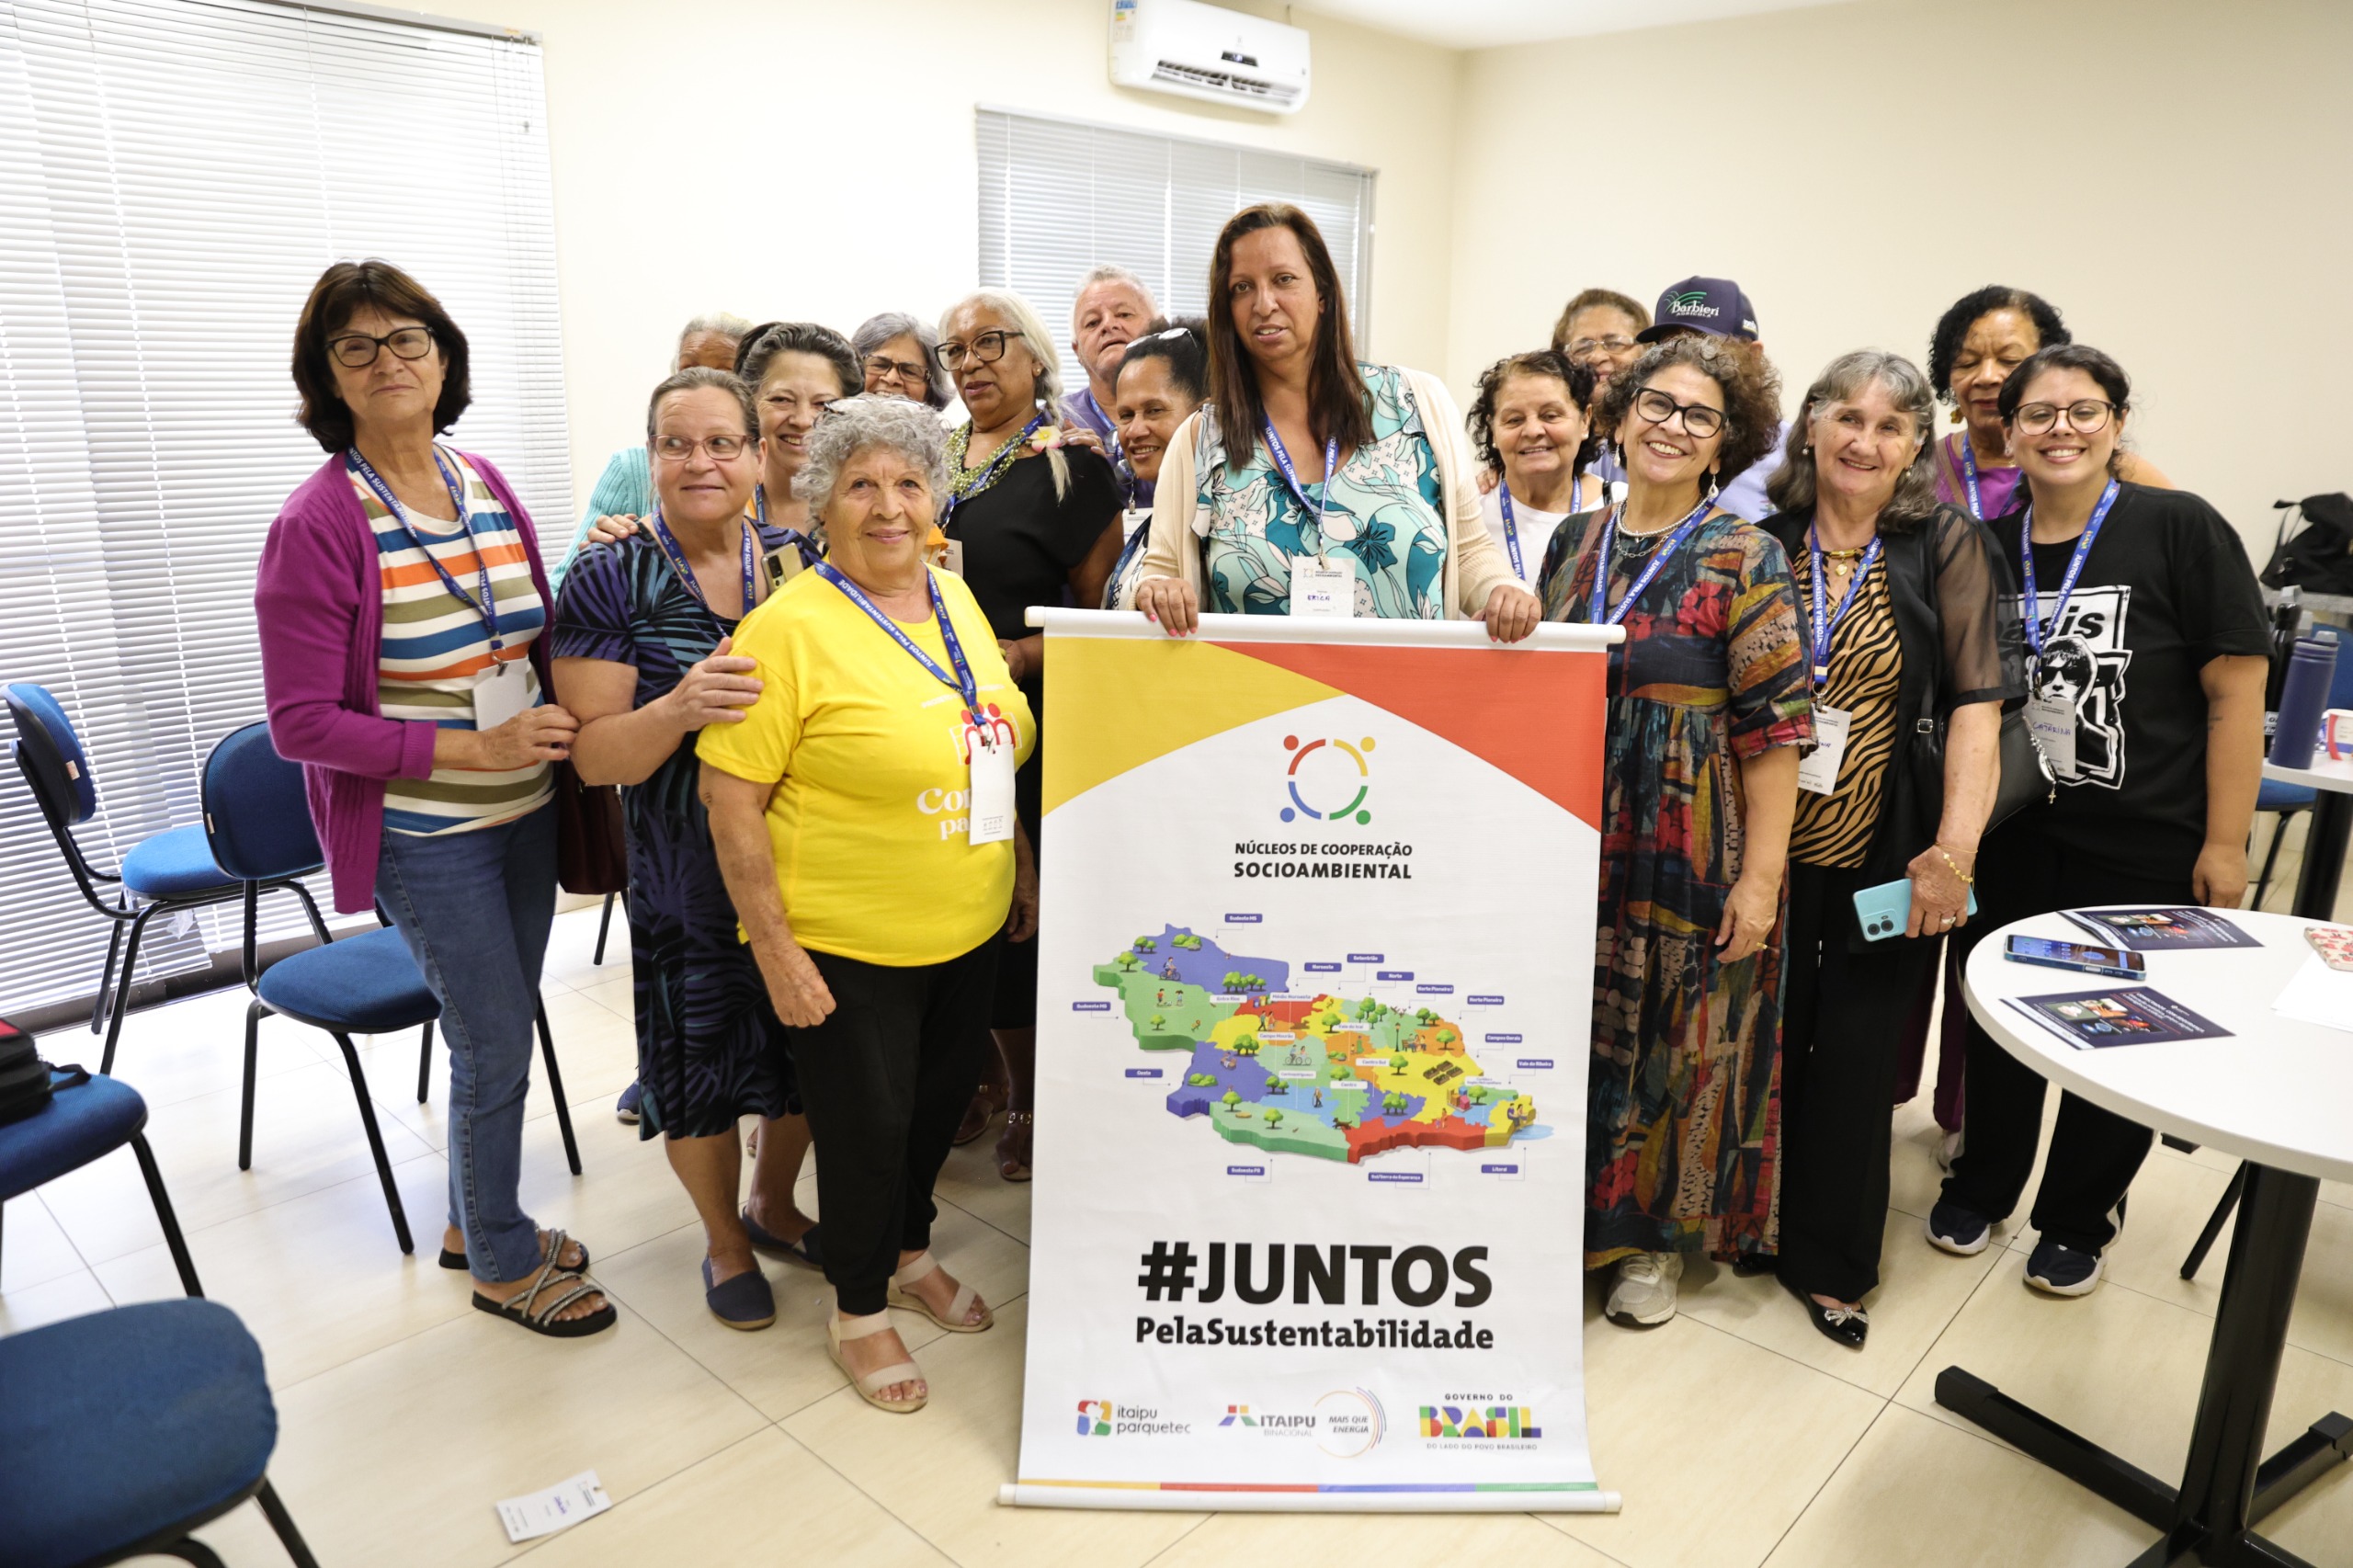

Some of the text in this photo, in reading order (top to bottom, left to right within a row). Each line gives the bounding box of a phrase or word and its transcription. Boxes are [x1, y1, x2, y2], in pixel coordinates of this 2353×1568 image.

[1671, 300, 1720, 316] Barbieri
[348, 447, 364, 464] NTOS
[359, 462, 375, 479] PELA
[1277, 449, 1289, 465] PELA
[1509, 540, 1519, 563] JUNTOS
[1867, 537, 1882, 559] JUNTOS
[1641, 559, 1661, 584] JUNTOS
[2067, 553, 2083, 581] JUNTOS
[481, 570, 490, 586] PELA
[1814, 551, 1823, 609] SUSTENTABILIDADE
[1629, 582, 1643, 597] PELA
[2060, 580, 2073, 596] PELA
[838, 579, 934, 668] JUNTOS PELA SUSTENTABILIDADE
[1235, 840, 1413, 859] NÚCLEOS DE COOPERAÇÃO
[1234, 862, 1412, 879] SOCIOAMBIENTAL
[1138, 1241, 1493, 1308] #JUNTOS
[1136, 1315, 1494, 1349] PelaSustentabilidade
[1117, 1404, 1158, 1420] itaipu
[1260, 1415, 1316, 1427] ITAIPU
[1351, 1415, 1369, 1424] QUE
[1117, 1421, 1191, 1436] parquetec
[1419, 1405, 1542, 1438] BRASIL
[1264, 1428, 1313, 1437] BINACIONAL
